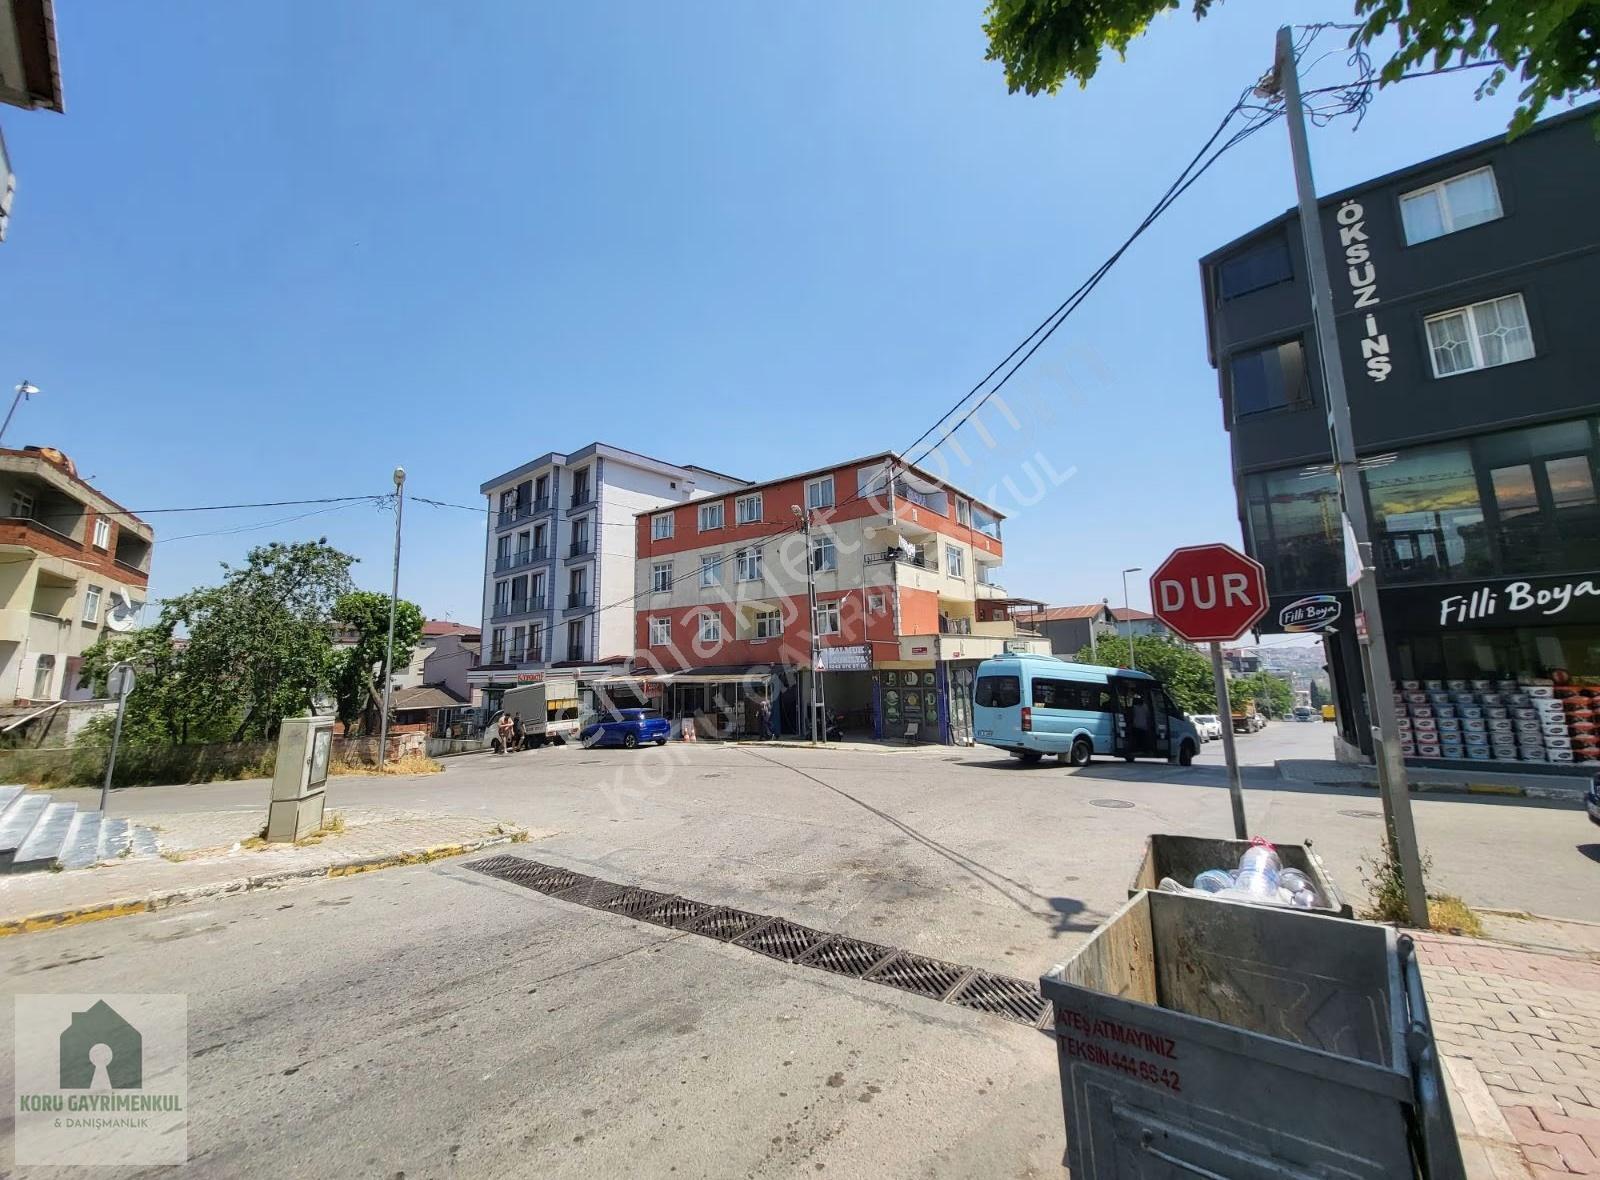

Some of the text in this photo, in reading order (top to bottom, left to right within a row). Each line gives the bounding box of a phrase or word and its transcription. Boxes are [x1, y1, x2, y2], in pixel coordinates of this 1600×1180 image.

[1336, 199, 1392, 382] ÖKSÜZ İNŞ
[1159, 572, 1253, 613] DUR
[1440, 580, 1600, 626] Filli Boya
[1284, 605, 1337, 624] Filli Boya
[1093, 1019, 1178, 1060] ATMAYINIZ
